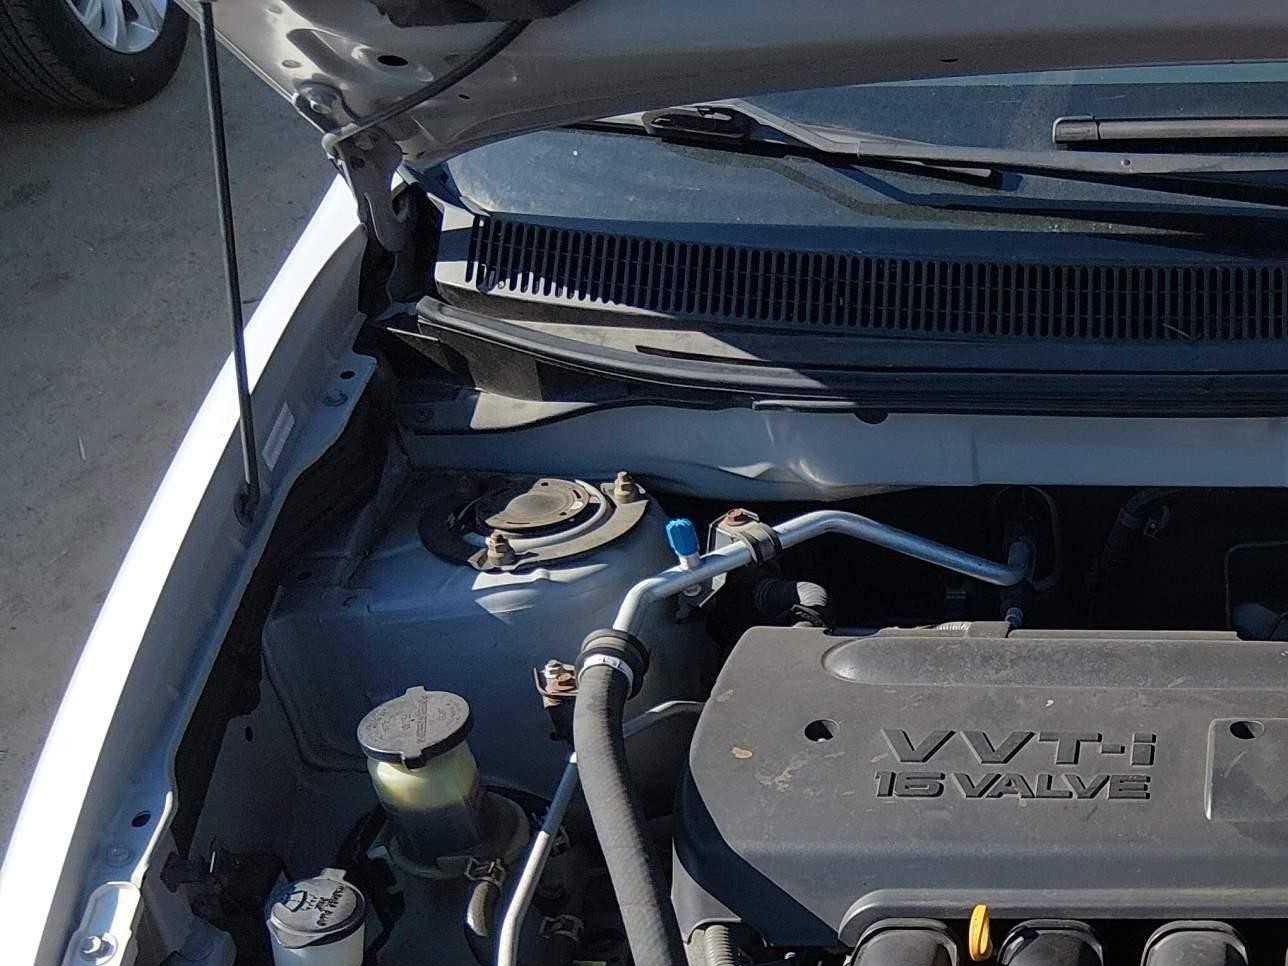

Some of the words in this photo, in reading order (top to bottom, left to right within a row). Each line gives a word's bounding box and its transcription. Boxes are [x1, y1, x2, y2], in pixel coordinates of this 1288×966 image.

[880, 729, 1156, 765] VVT-i
[875, 771, 946, 797] 16
[952, 772, 1152, 800] VALVE
